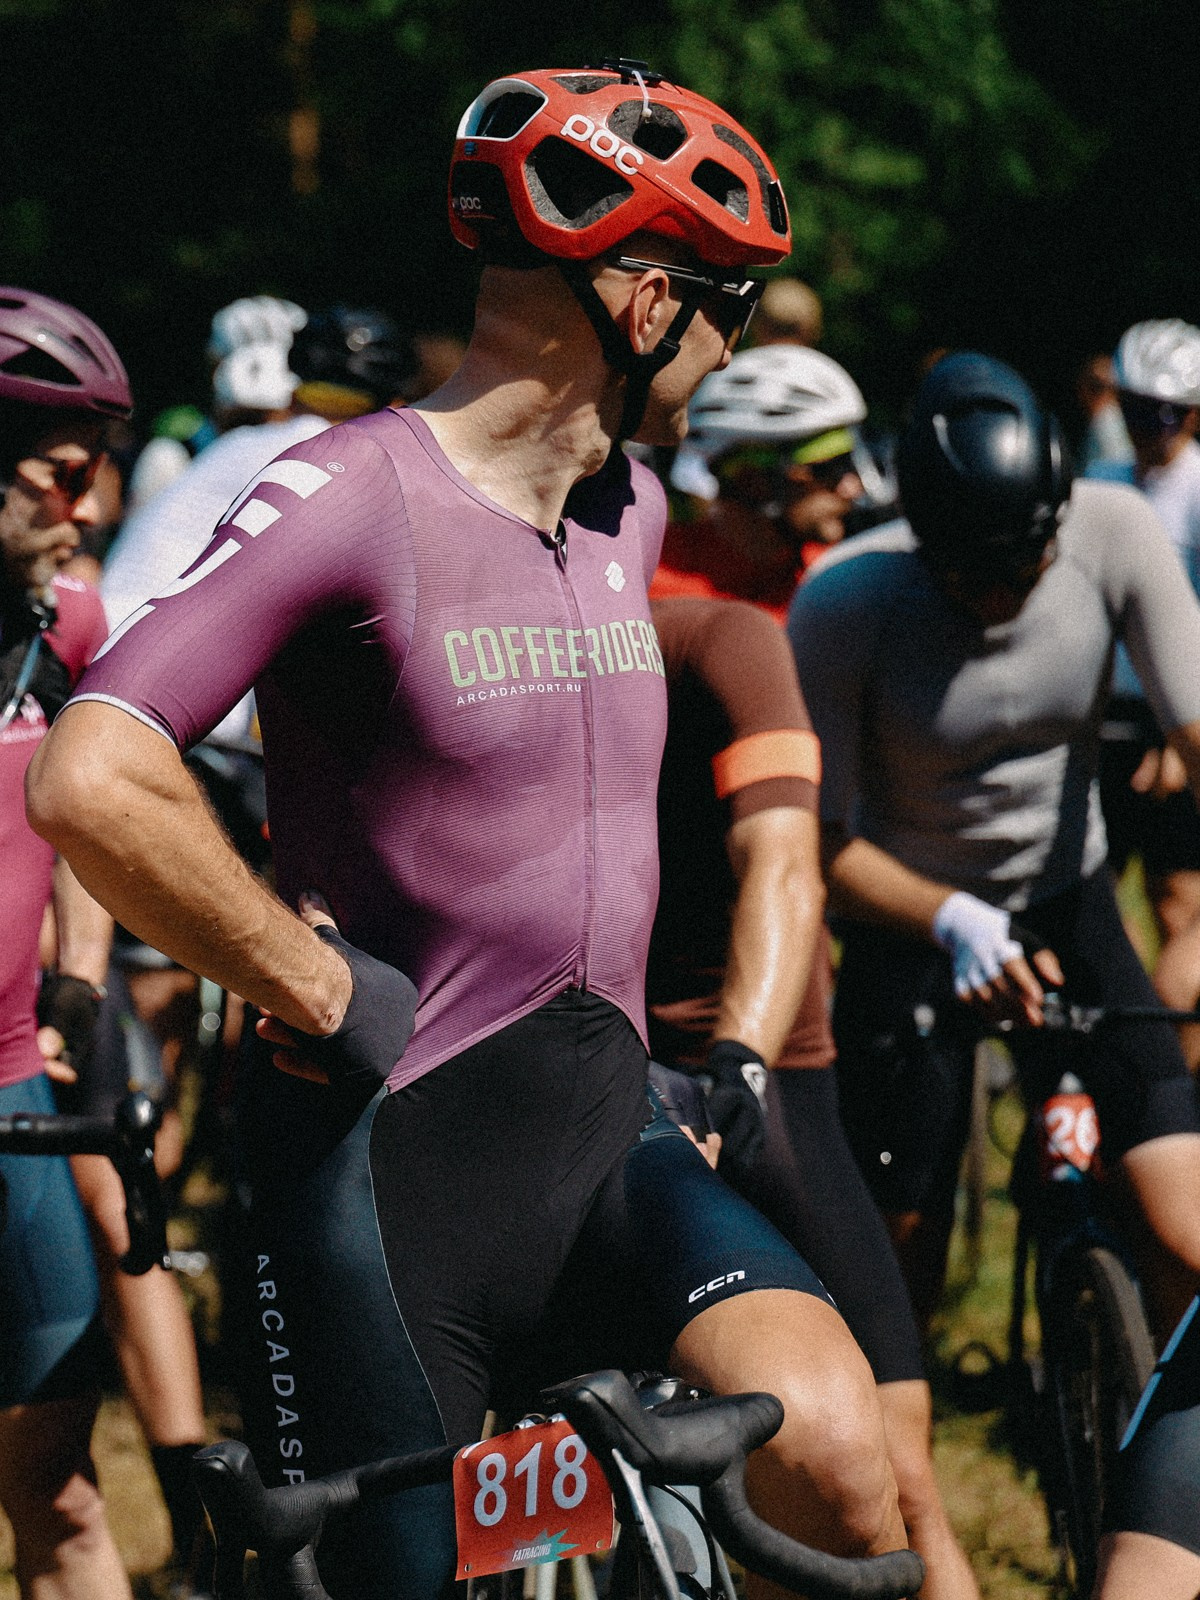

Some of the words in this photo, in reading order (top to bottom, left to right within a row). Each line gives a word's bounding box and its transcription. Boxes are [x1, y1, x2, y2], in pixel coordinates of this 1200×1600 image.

[443, 619, 667, 688] COFFEERIDERS
[456, 683, 582, 706] ARCADASPORT.RU
[473, 1434, 589, 1527] 818
